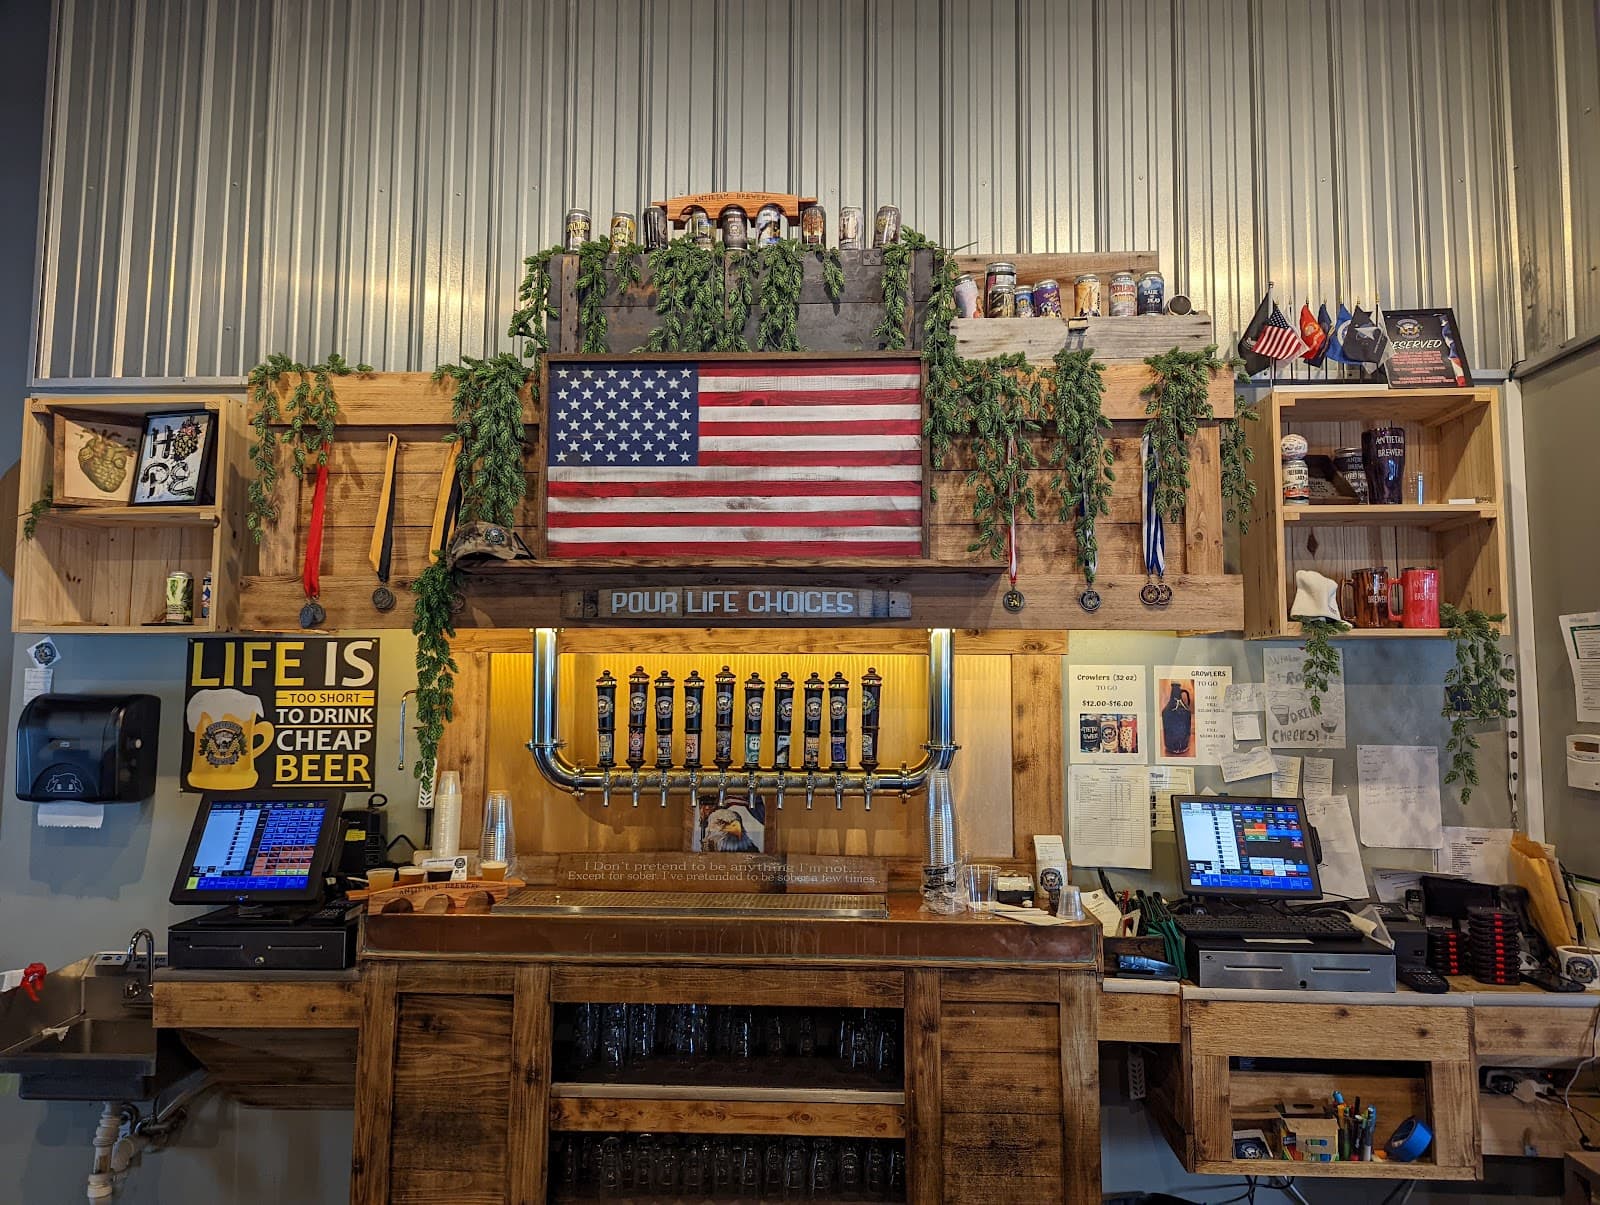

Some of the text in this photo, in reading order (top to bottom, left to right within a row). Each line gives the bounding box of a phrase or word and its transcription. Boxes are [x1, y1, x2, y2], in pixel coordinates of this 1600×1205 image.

[736, 193, 771, 201] BREWERY
[611, 590, 854, 614] POUR LIFE CHOICES
[191, 640, 374, 687] LIFE IS
[1077, 673, 1110, 681] Crowlers
[289, 693, 361, 703] TOO SHORT
[275, 708, 374, 724] TO DRINK
[276, 729, 372, 752] CHEAP
[275, 754, 371, 782] BEER
[584, 862, 589, 870] I
[594, 861, 629, 871] Don't
[634, 861, 687, 873] pretend
[691, 862, 706, 871] to
[710, 861, 727, 871] be
[730, 862, 794, 874] anything
[799, 863, 821, 872] I'm
[568, 871, 606, 881] Except
[609, 871, 625, 880] for
[663, 871, 684, 880] I've
[686, 872, 743, 882] pretended
[746, 872, 759, 881] to
[761, 872, 775, 881] be
[821, 873, 842, 882] few
